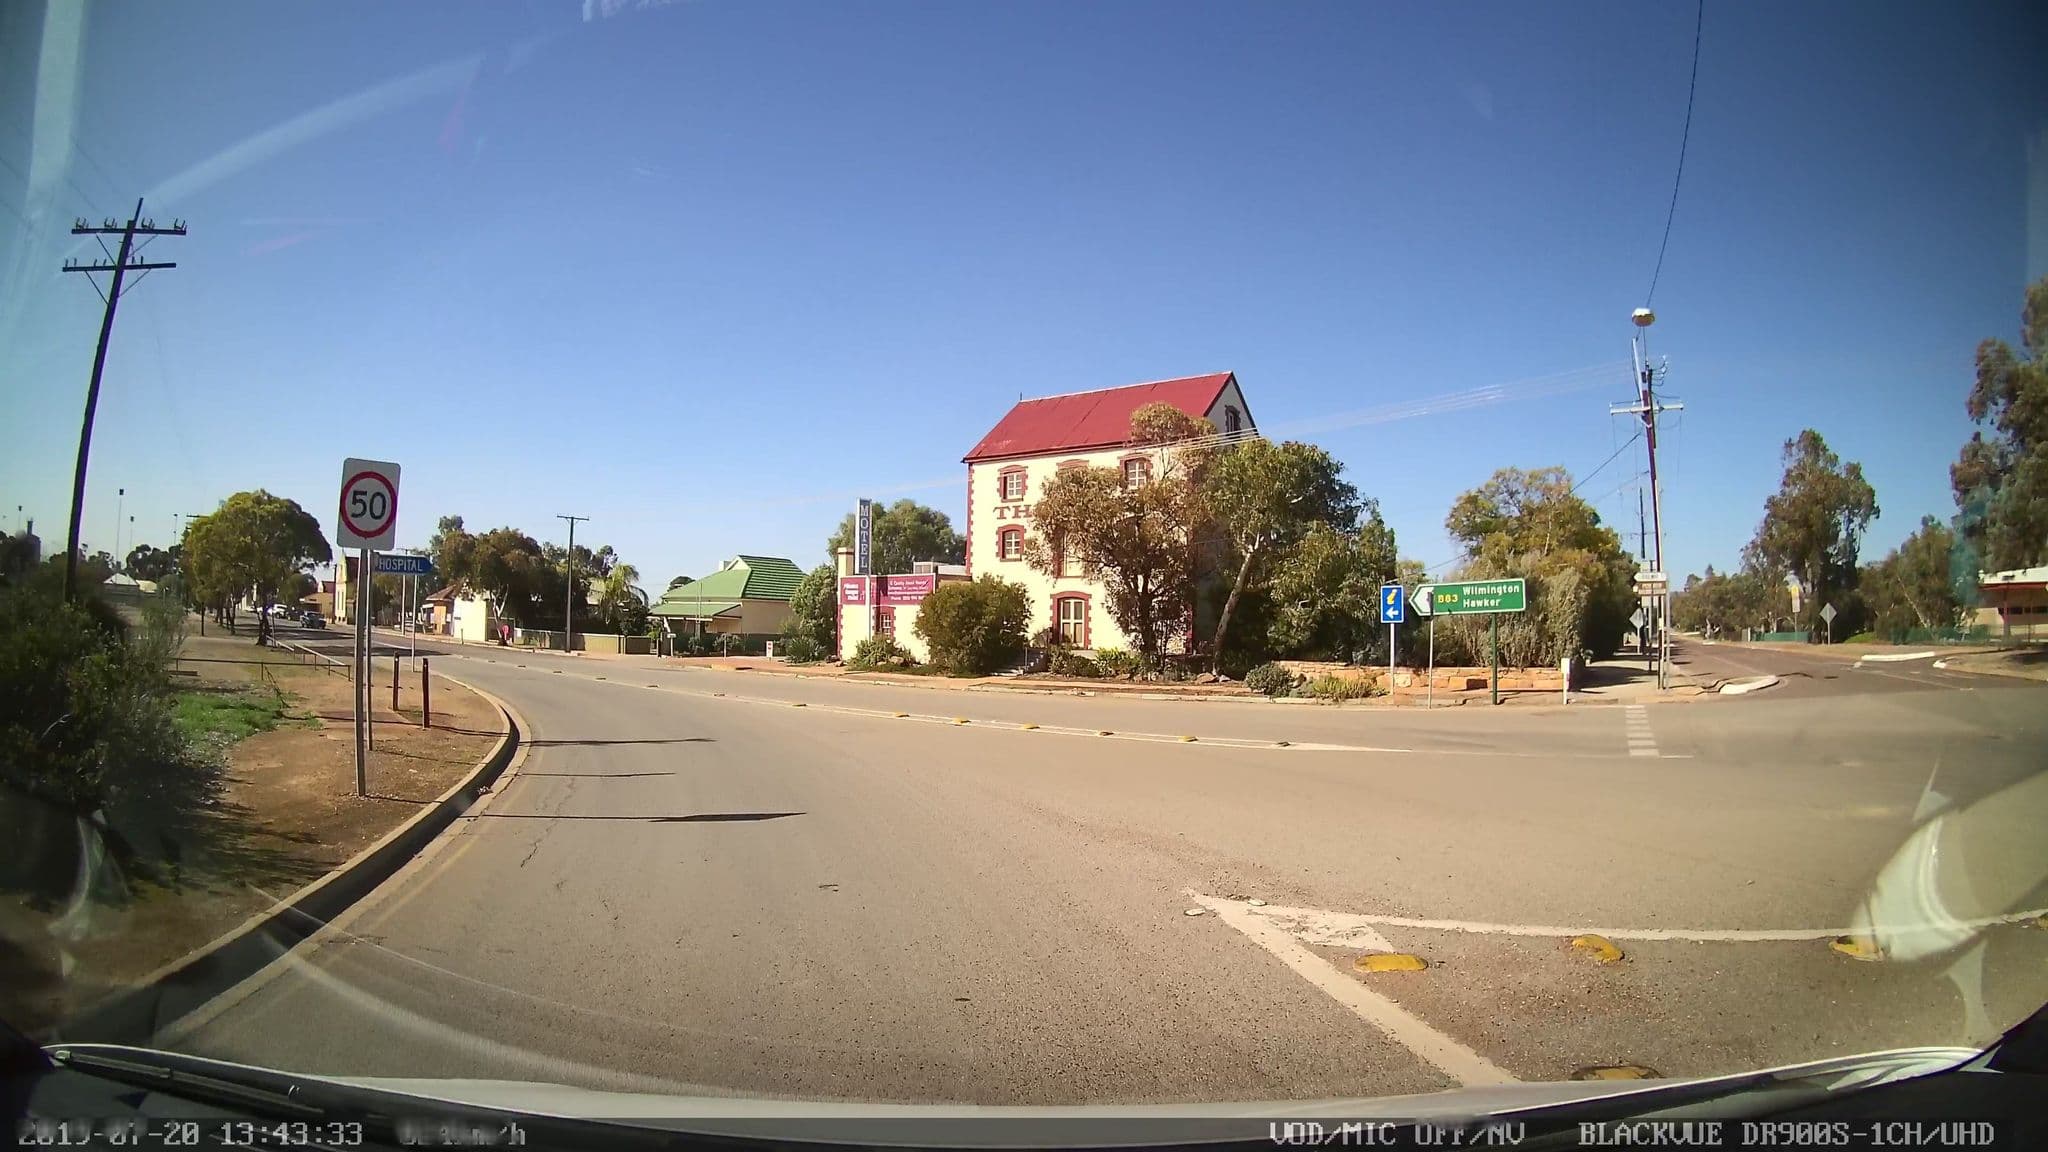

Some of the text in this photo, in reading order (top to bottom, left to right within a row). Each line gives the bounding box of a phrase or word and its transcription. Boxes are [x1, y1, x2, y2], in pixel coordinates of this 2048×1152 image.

[351, 490, 387, 520] 50
[860, 505, 869, 568] MOTEL
[378, 559, 423, 572] HOSPITAL
[1463, 585, 1519, 596] Wilmington
[1438, 594, 1458, 603] B83
[1463, 598, 1501, 608] Hawker
